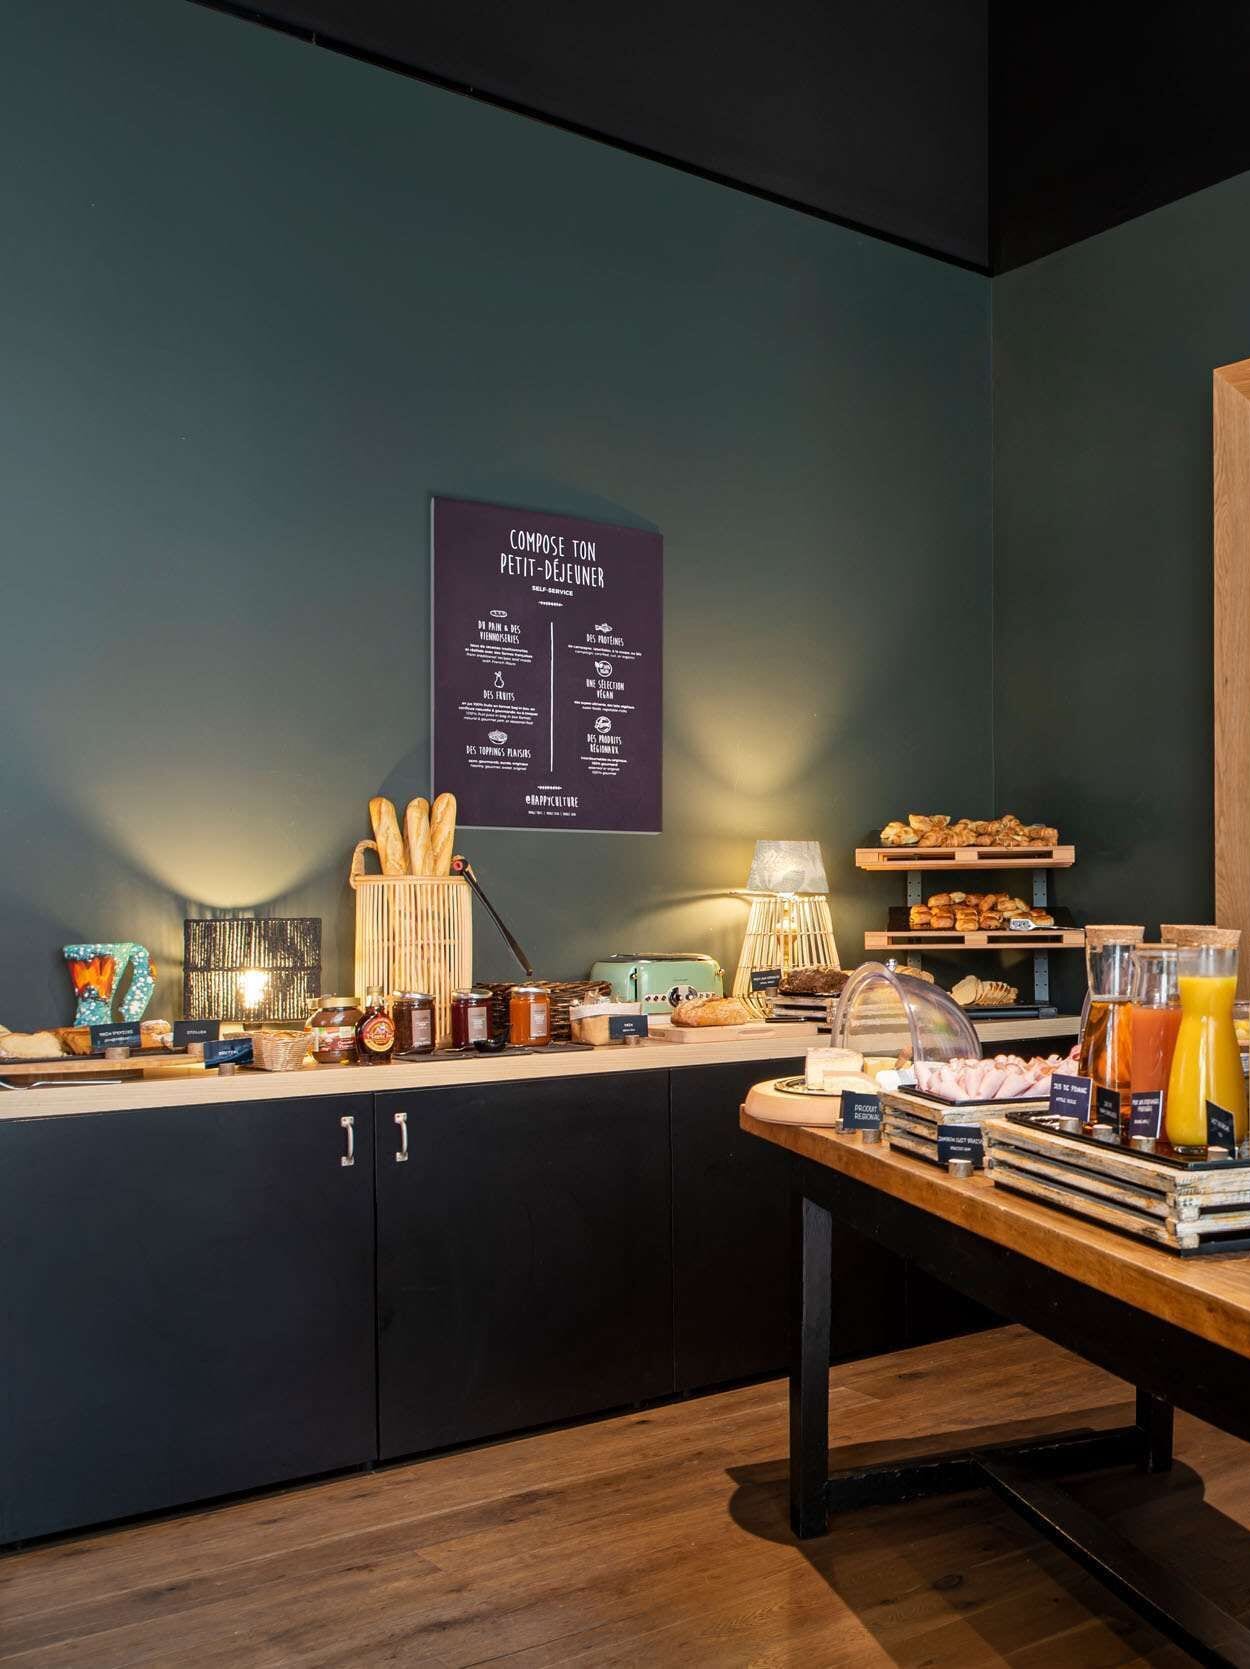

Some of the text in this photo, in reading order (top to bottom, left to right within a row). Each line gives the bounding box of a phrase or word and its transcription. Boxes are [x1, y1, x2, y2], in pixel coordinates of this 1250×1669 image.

[510, 529, 596, 562] COMPOSE TON
[500, 552, 605, 588] PETIT-DÉJEUNER
[531, 585, 574, 597] SELF-SERVICE
[488, 621, 502, 632] PAIN
[510, 624, 521, 635] DES
[480, 631, 520, 645] VIENNOISERIES
[586, 633, 596, 644] DES
[598, 679, 625, 691] SÉLECTION
[483, 689, 516, 702] DES FRUITS
[466, 745, 477, 756] DES
[479, 746, 505, 757] TOPPINGS
[854, 1104, 878, 1113] PRODUIT
